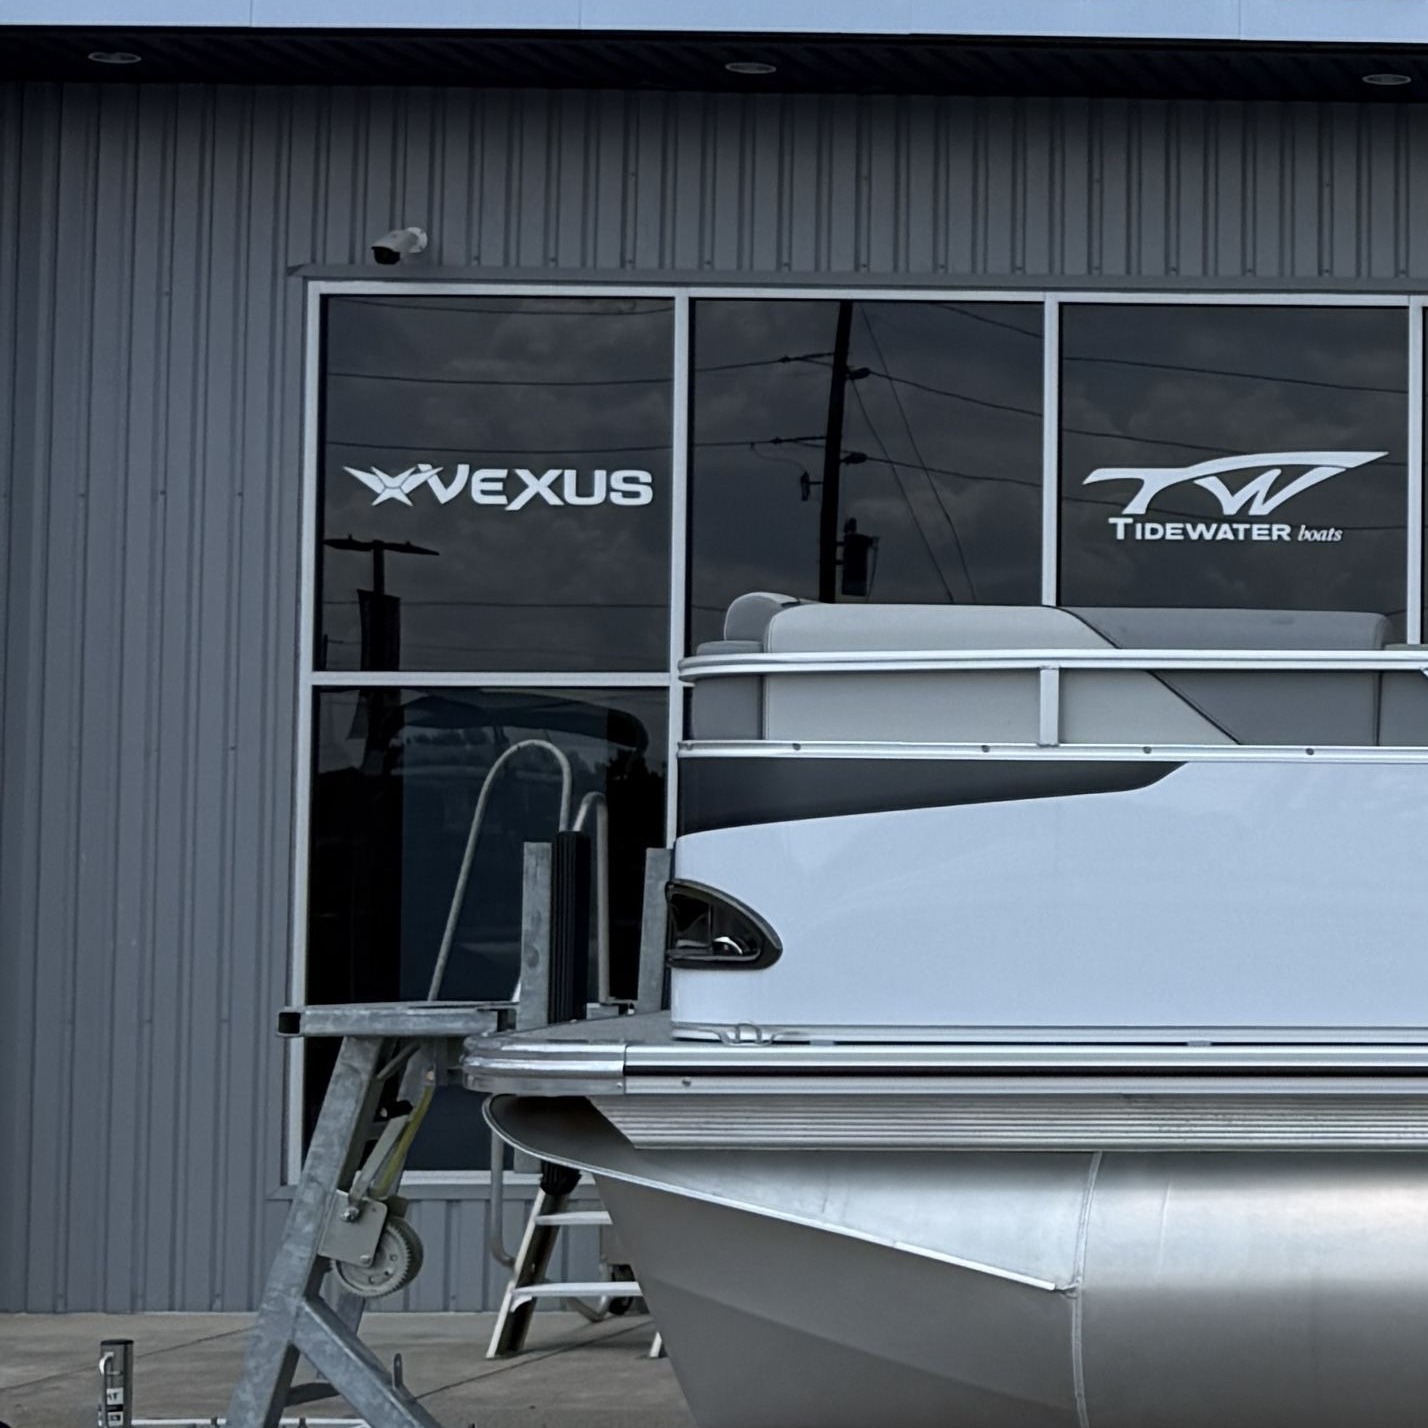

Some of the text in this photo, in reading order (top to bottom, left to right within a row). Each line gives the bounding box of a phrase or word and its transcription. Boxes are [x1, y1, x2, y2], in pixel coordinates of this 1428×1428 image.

[419, 463, 654, 511] VEXUS
[1108, 516, 1343, 544] TIDEWATER boats
